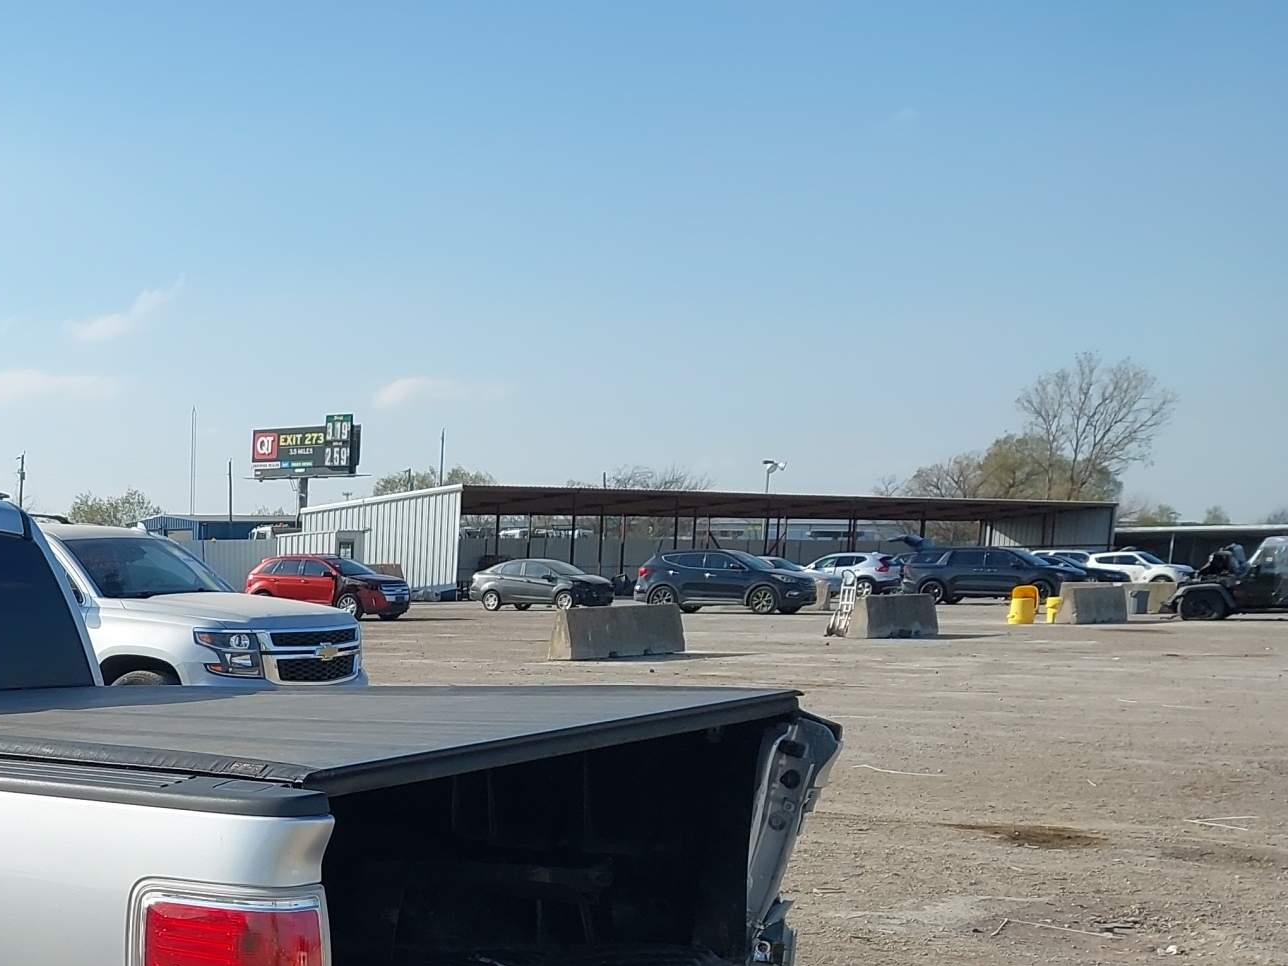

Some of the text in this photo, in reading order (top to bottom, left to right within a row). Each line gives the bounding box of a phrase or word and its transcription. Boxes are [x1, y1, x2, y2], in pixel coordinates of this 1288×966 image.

[256, 436, 274, 455] QT
[279, 433, 325, 446] EXIT 273
